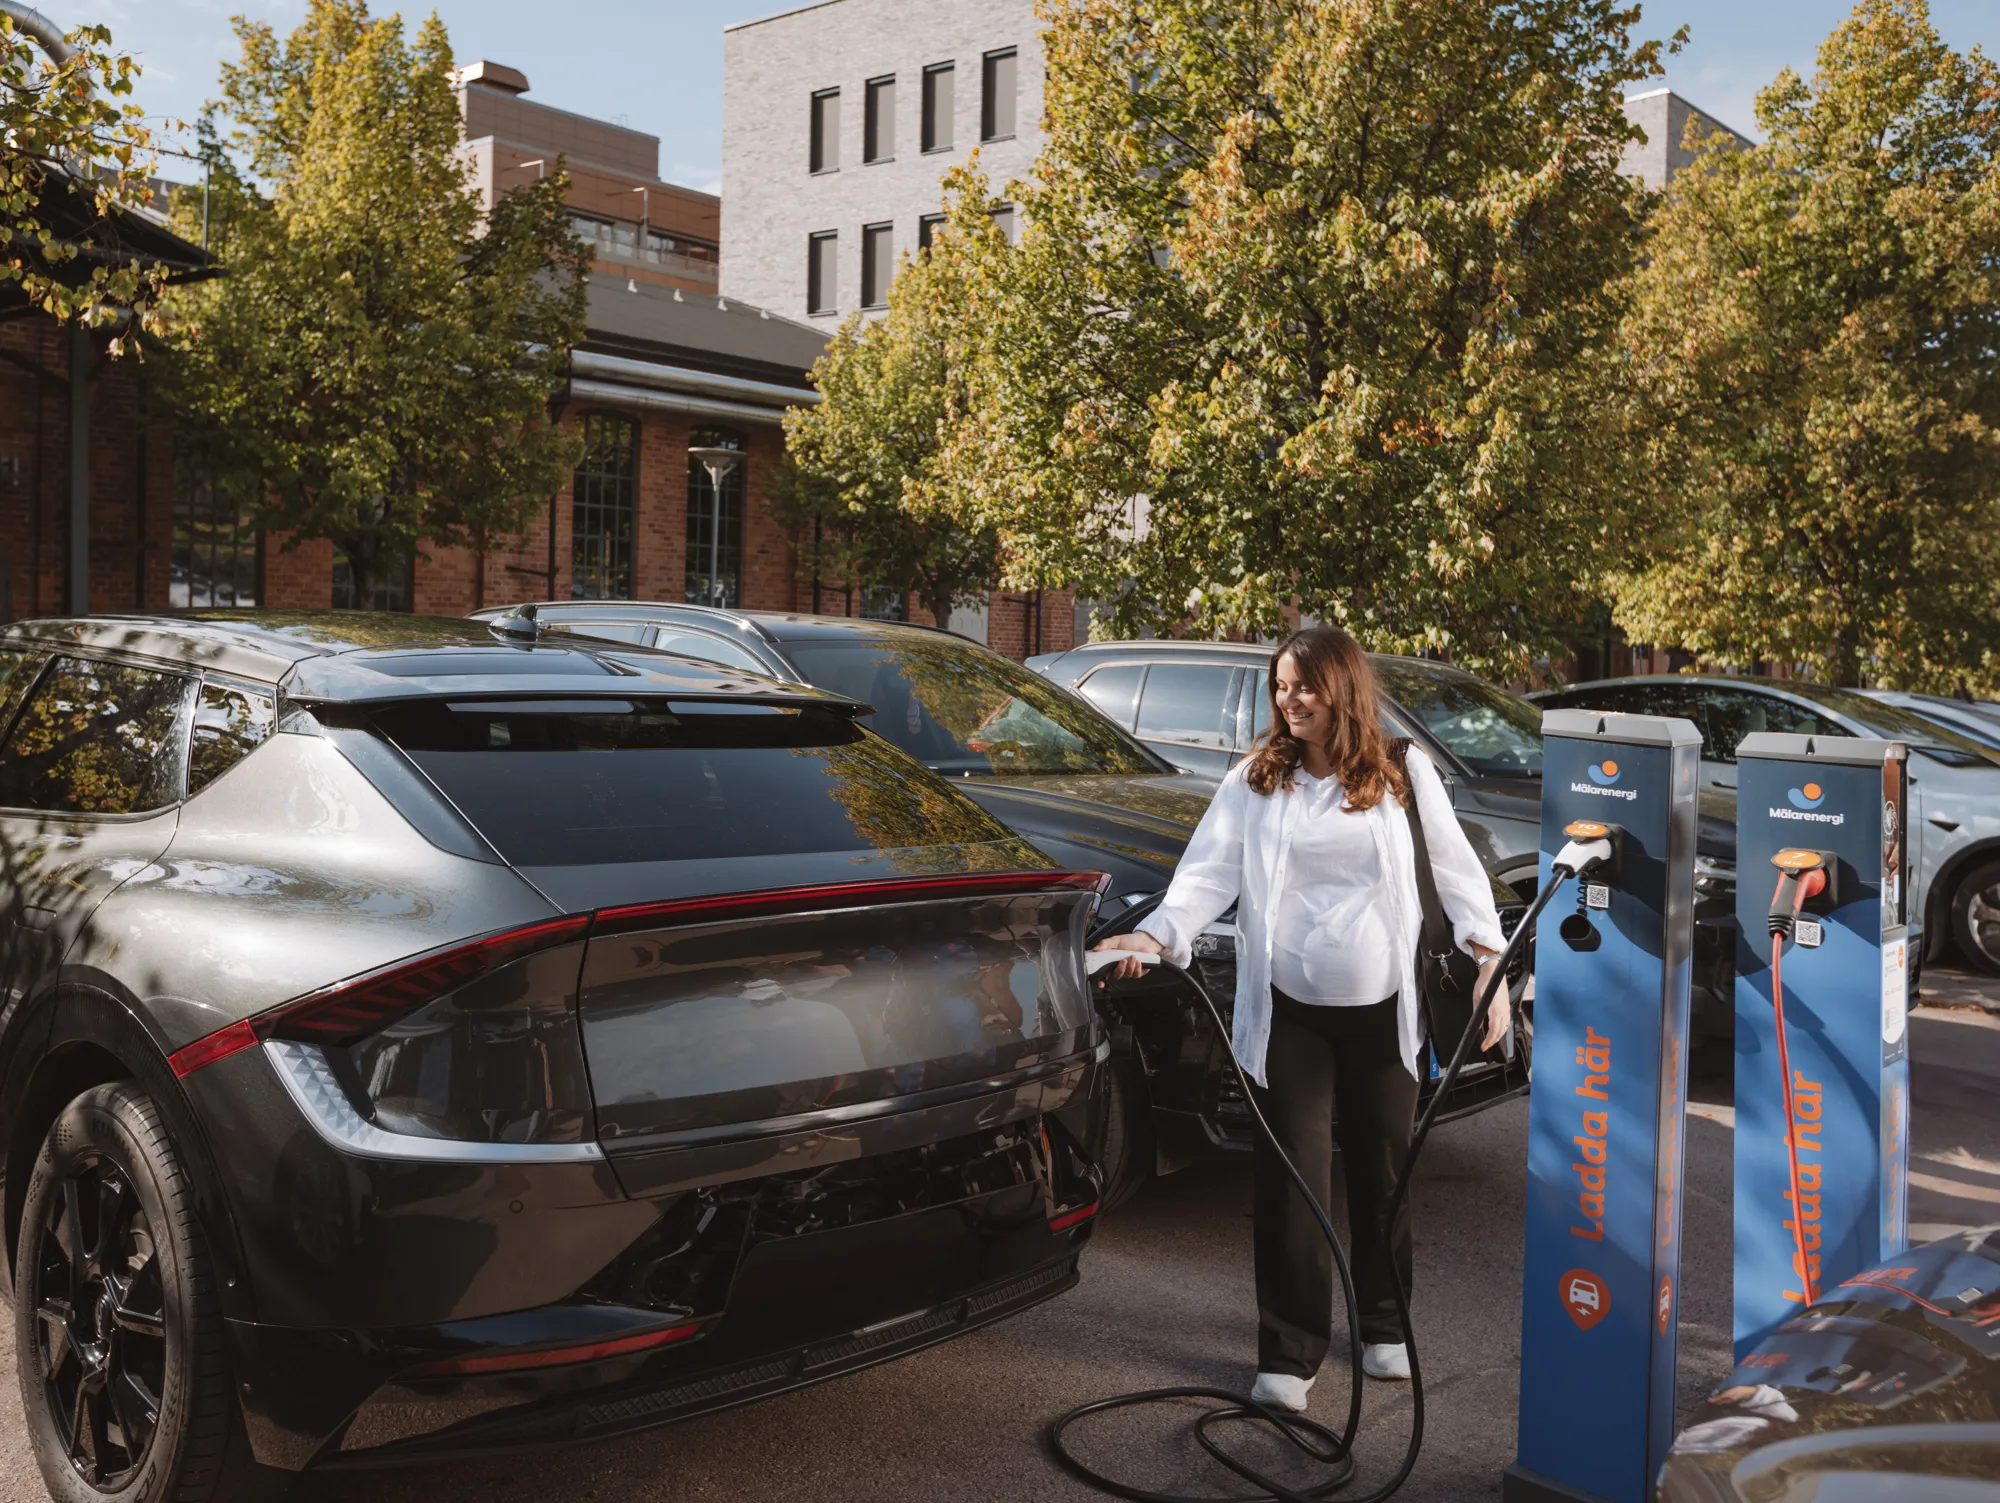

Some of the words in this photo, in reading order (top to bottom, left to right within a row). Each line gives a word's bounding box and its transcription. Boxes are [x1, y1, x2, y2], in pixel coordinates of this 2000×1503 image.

[1571, 782, 1638, 800] Mälarenergi
[1769, 808, 1844, 825] Mälarenergi
[1576, 1026, 1612, 1101] här
[1571, 1111, 1609, 1241] Ladda
